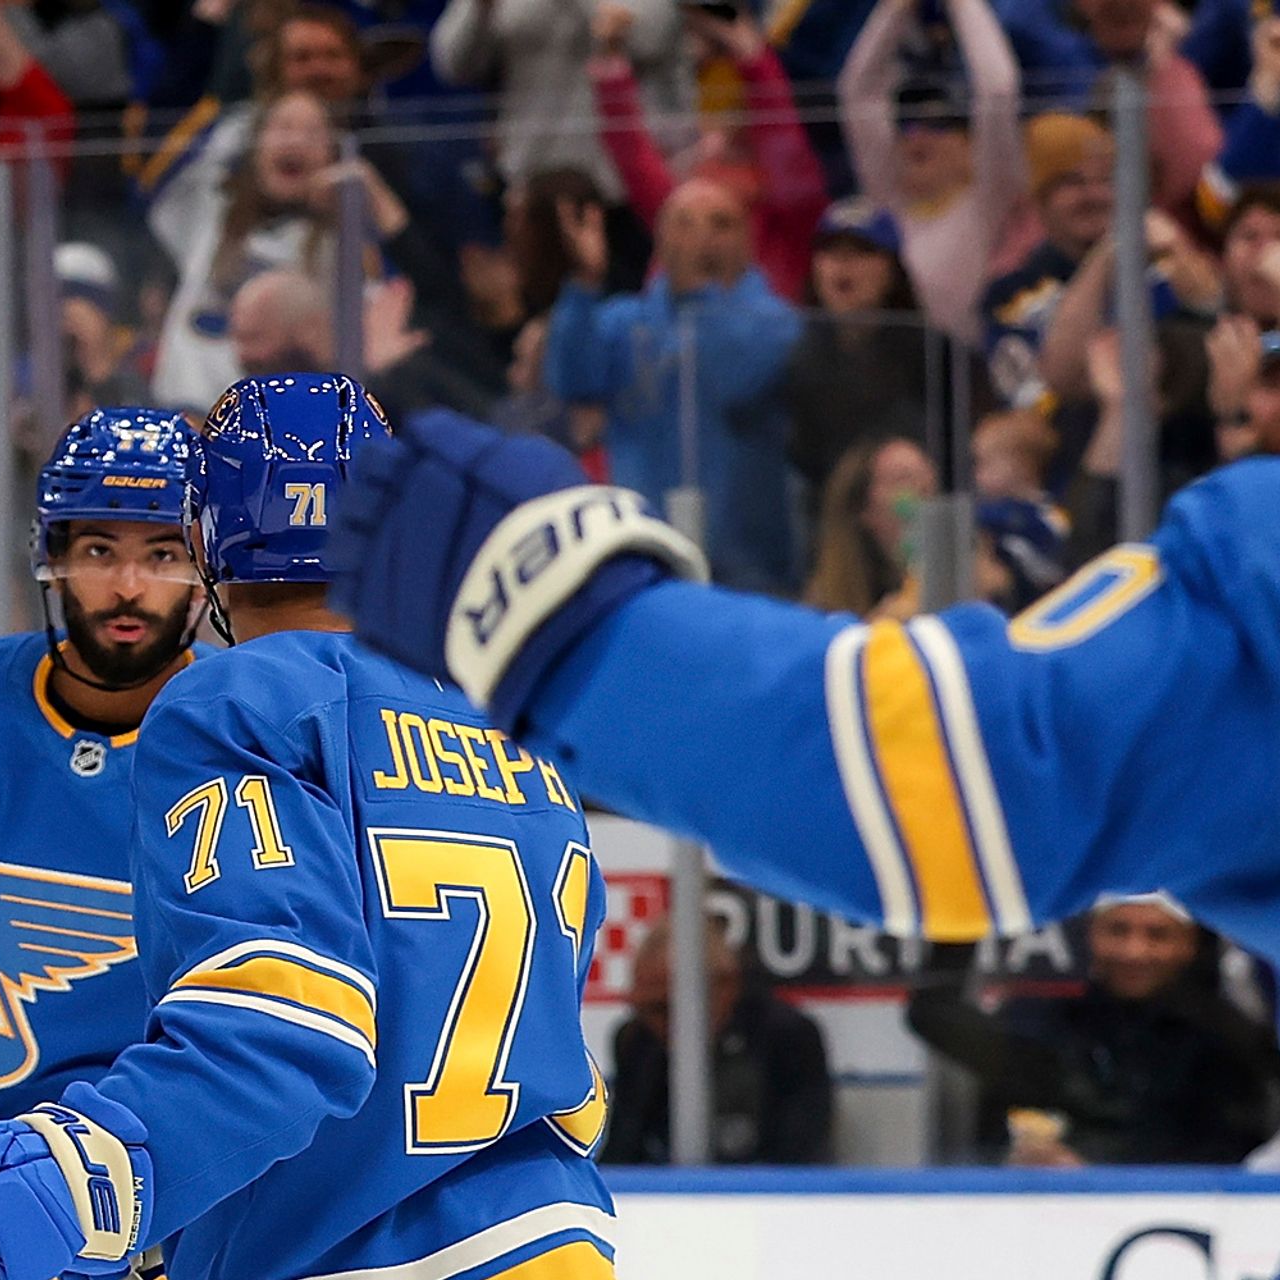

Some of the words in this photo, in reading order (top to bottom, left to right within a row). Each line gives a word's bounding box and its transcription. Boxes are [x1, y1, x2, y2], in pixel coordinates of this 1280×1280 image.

[102, 475, 168, 488] BAUER
[285, 482, 328, 527] 71
[165, 774, 296, 895] 71
